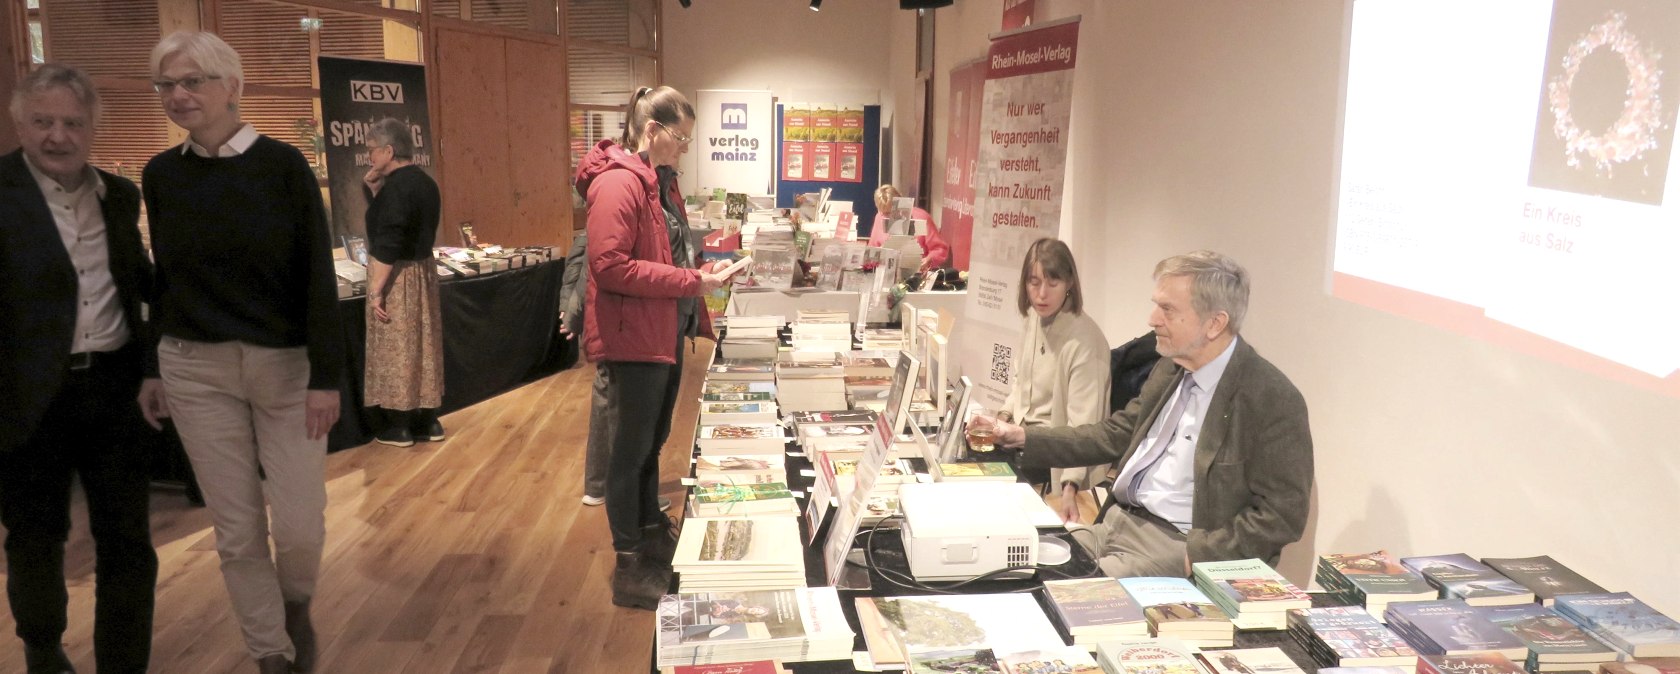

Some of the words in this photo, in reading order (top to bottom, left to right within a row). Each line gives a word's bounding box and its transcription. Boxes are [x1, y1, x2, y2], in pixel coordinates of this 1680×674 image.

[352, 83, 400, 101] KBV
[1006, 101, 1025, 118] Nur
[1027, 101, 1046, 116] wer
[709, 134, 760, 151] verlag
[990, 127, 1060, 149] Vergangenheit
[711, 147, 757, 162] mainz
[999, 156, 1042, 174] versteht,
[987, 181, 1010, 199] kann
[1012, 183, 1052, 202] Zukunft
[991, 211, 1040, 229] gestalten.
[1522, 201, 1543, 220] Ein
[1546, 205, 1583, 229] Kreis
[1519, 231, 1542, 247] aus
[1545, 232, 1575, 254] Salz
